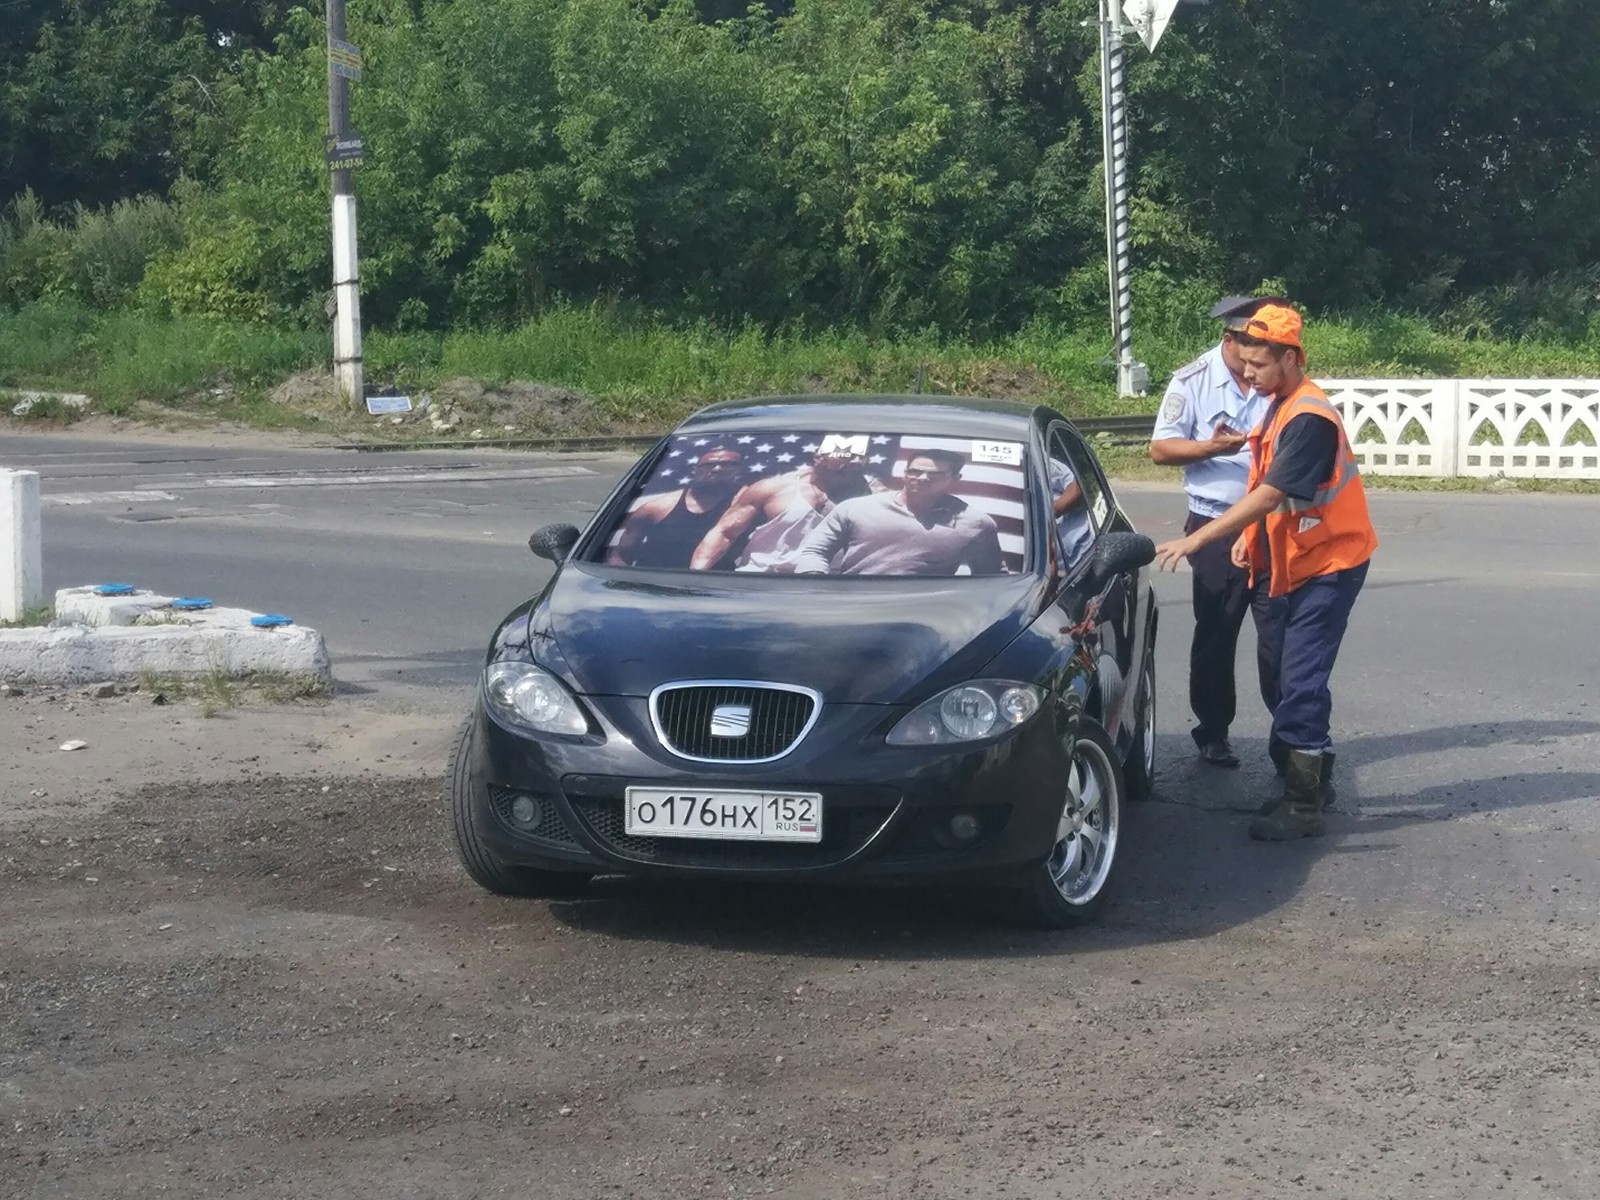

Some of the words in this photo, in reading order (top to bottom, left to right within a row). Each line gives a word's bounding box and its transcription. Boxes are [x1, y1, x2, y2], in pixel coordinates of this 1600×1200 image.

[979, 445, 1012, 454] 145
[767, 798, 812, 821] 152
[776, 822, 798, 831] RUS
